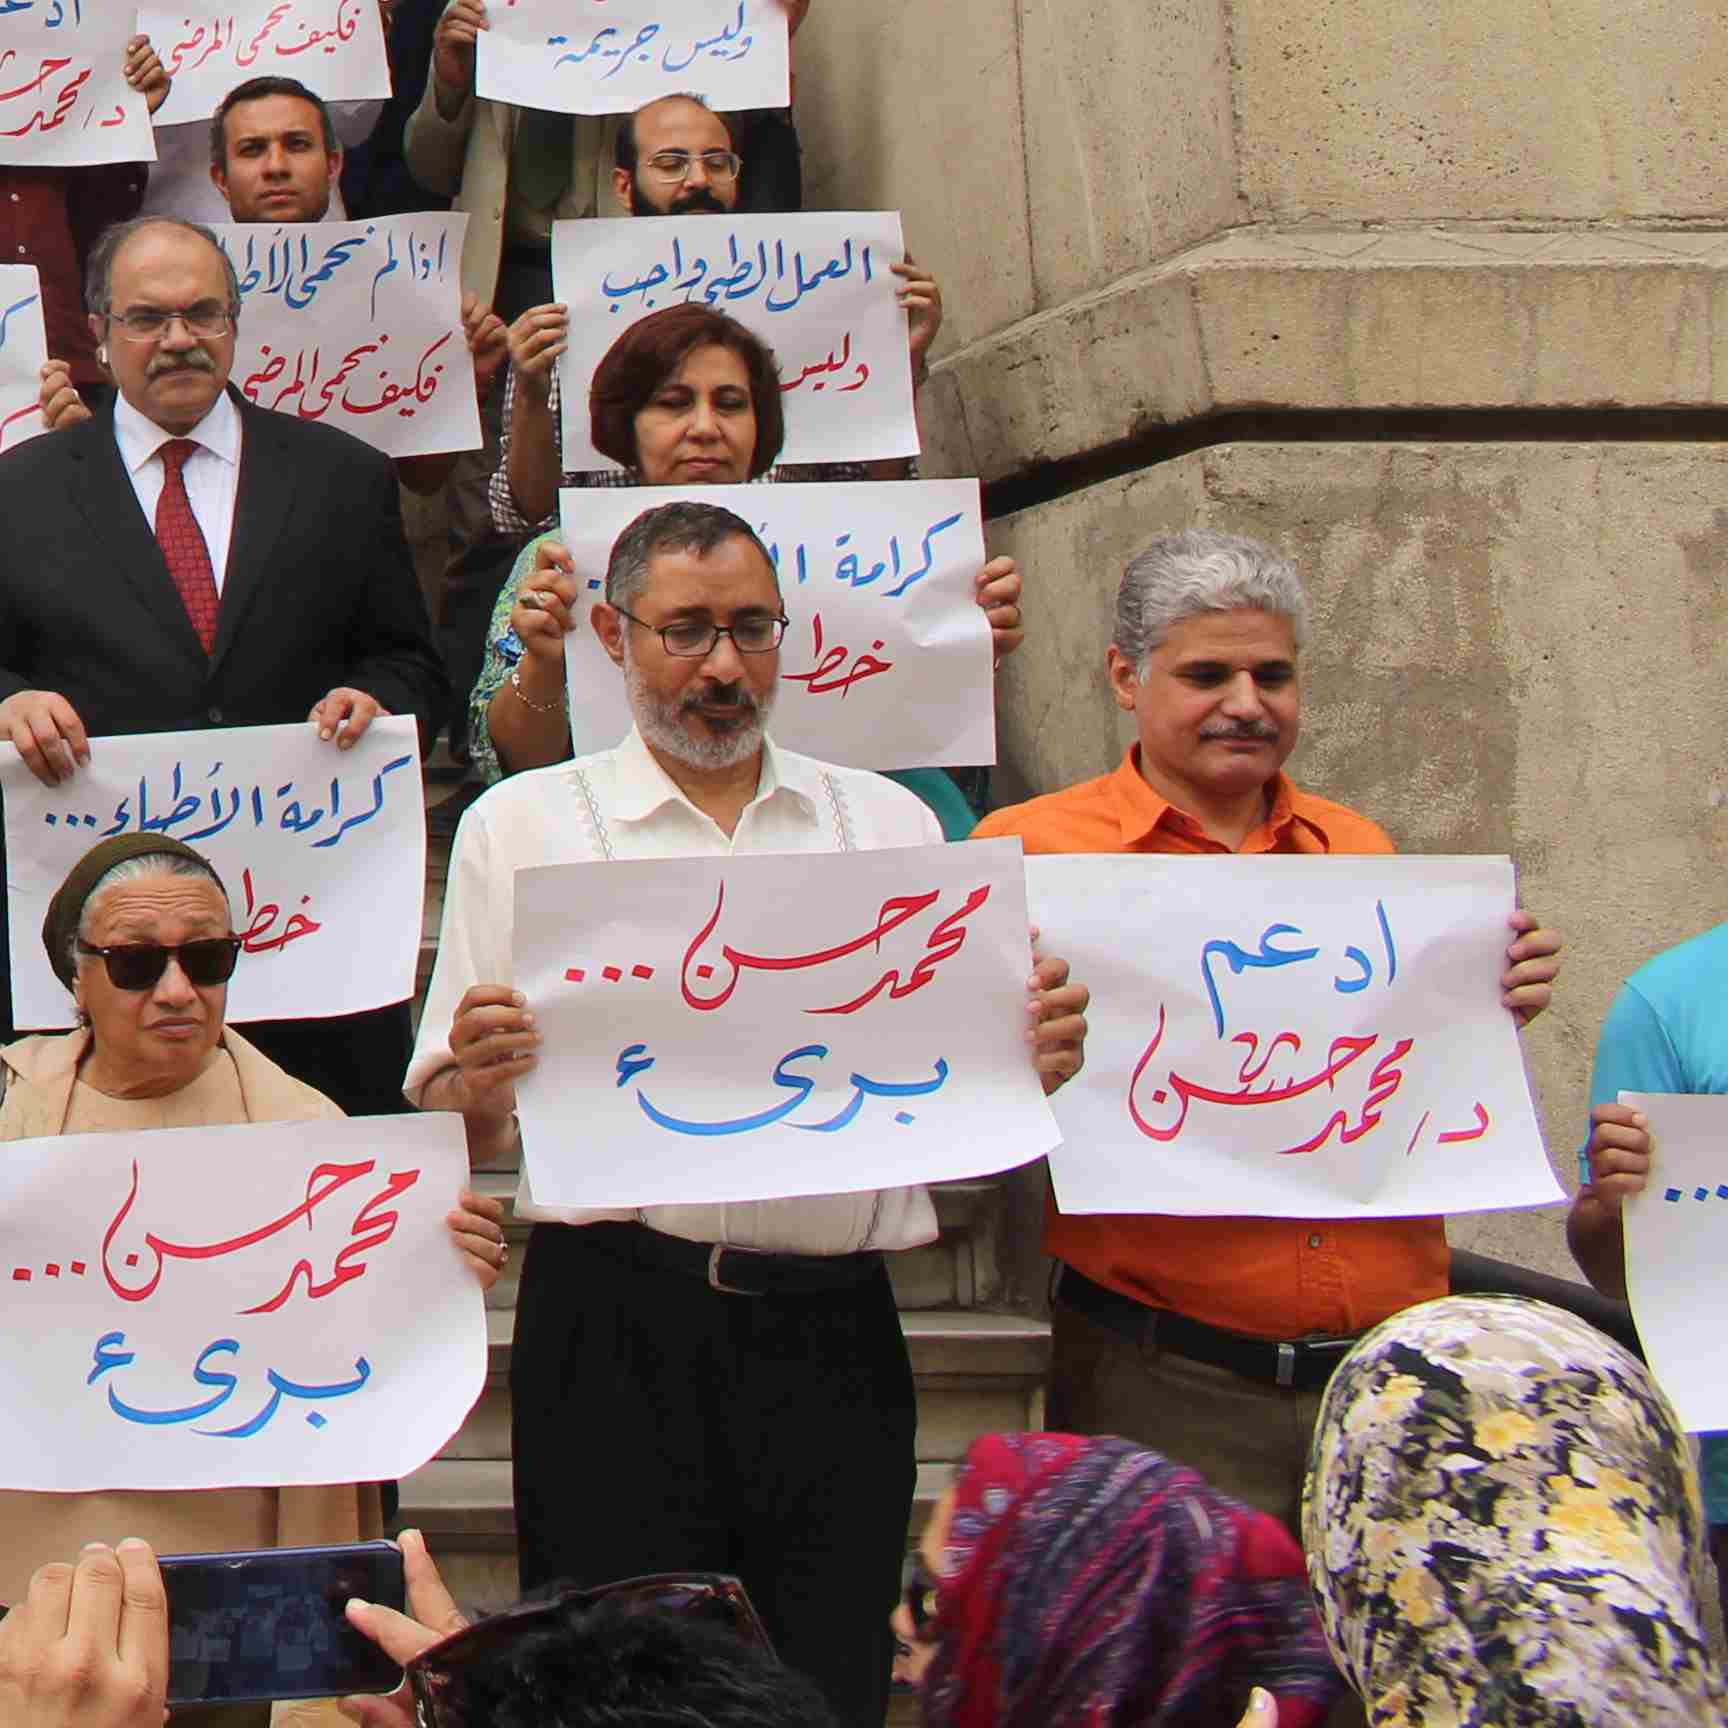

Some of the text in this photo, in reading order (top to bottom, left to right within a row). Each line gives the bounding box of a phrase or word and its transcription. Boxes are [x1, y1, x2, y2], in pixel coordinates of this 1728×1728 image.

[547, 0, 752, 80] وليس جريمة
[602, 237, 708, 313] واجب
[766, 239, 871, 312] العمل
[342, 331, 452, 416] فكيف
[834, 512, 964, 597] كرامة
[781, 613, 894, 699] خط
[278, 755, 412, 847] كرامة
[801, 884, 991, 1014] محمد
[1200, 899, 1397, 1040] ادعم
[1129, 1004, 1377, 1141] حسن
[1278, 1038, 1414, 1155] محمد
[237, 1170, 421, 1315] محمد
